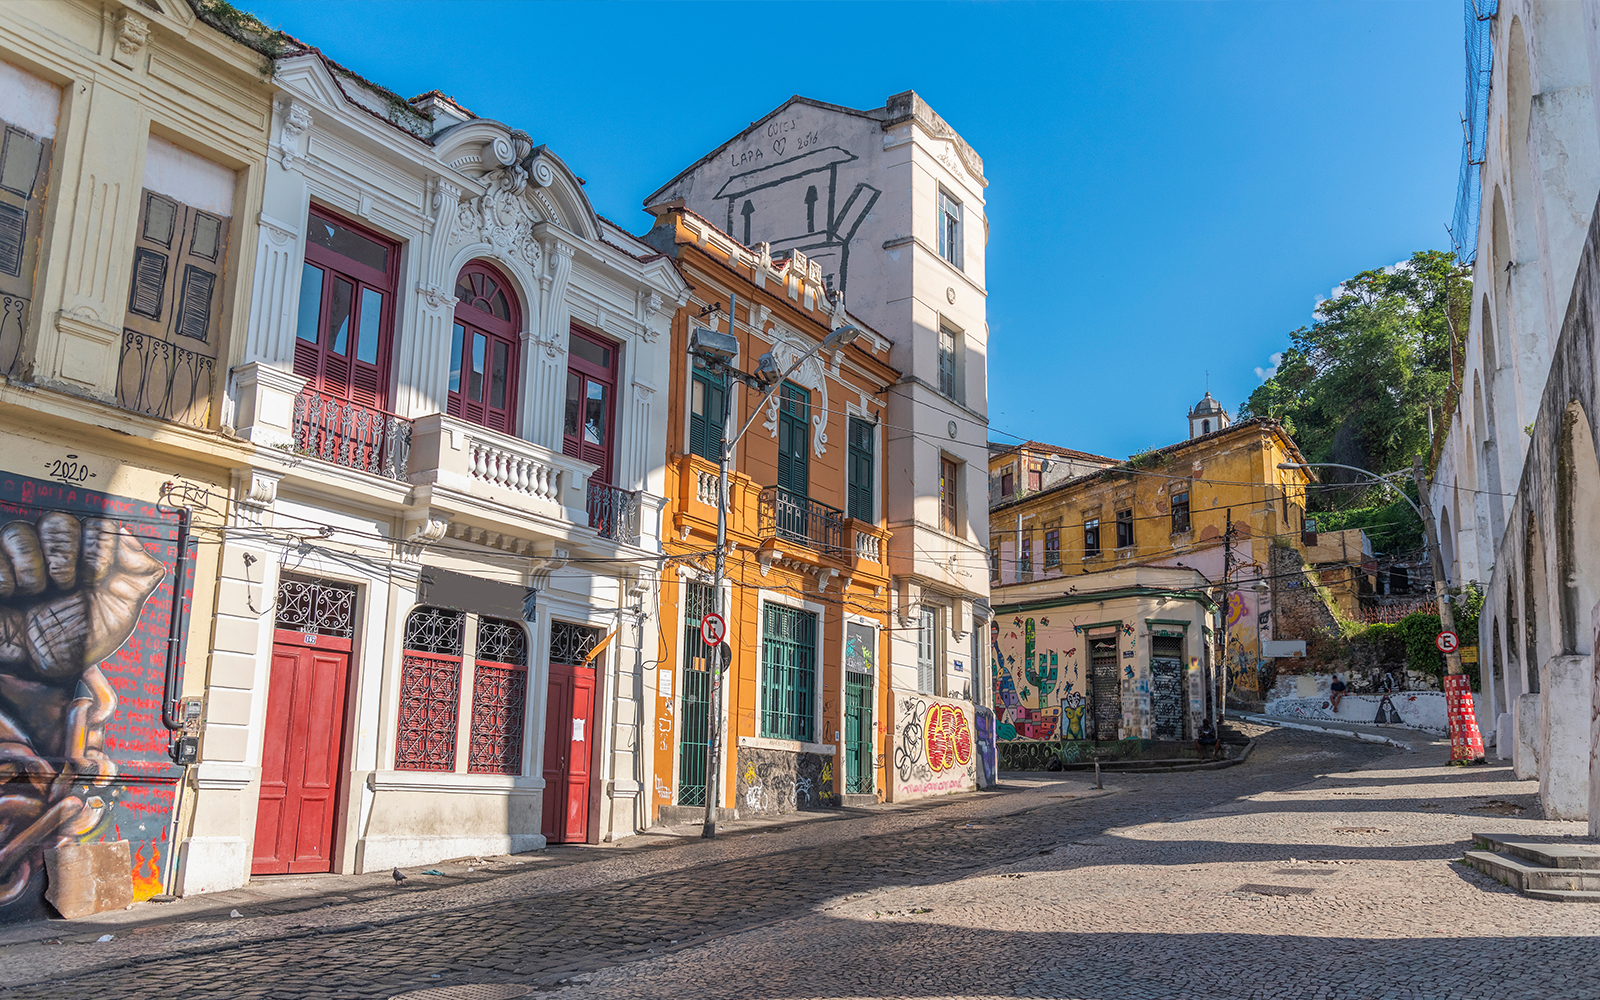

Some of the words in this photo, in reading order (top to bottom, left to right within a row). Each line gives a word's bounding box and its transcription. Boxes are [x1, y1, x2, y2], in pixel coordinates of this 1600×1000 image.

[731, 148, 764, 167] LAPA
[797, 131, 819, 150] 2016
[49, 459, 88, 482] 2020
